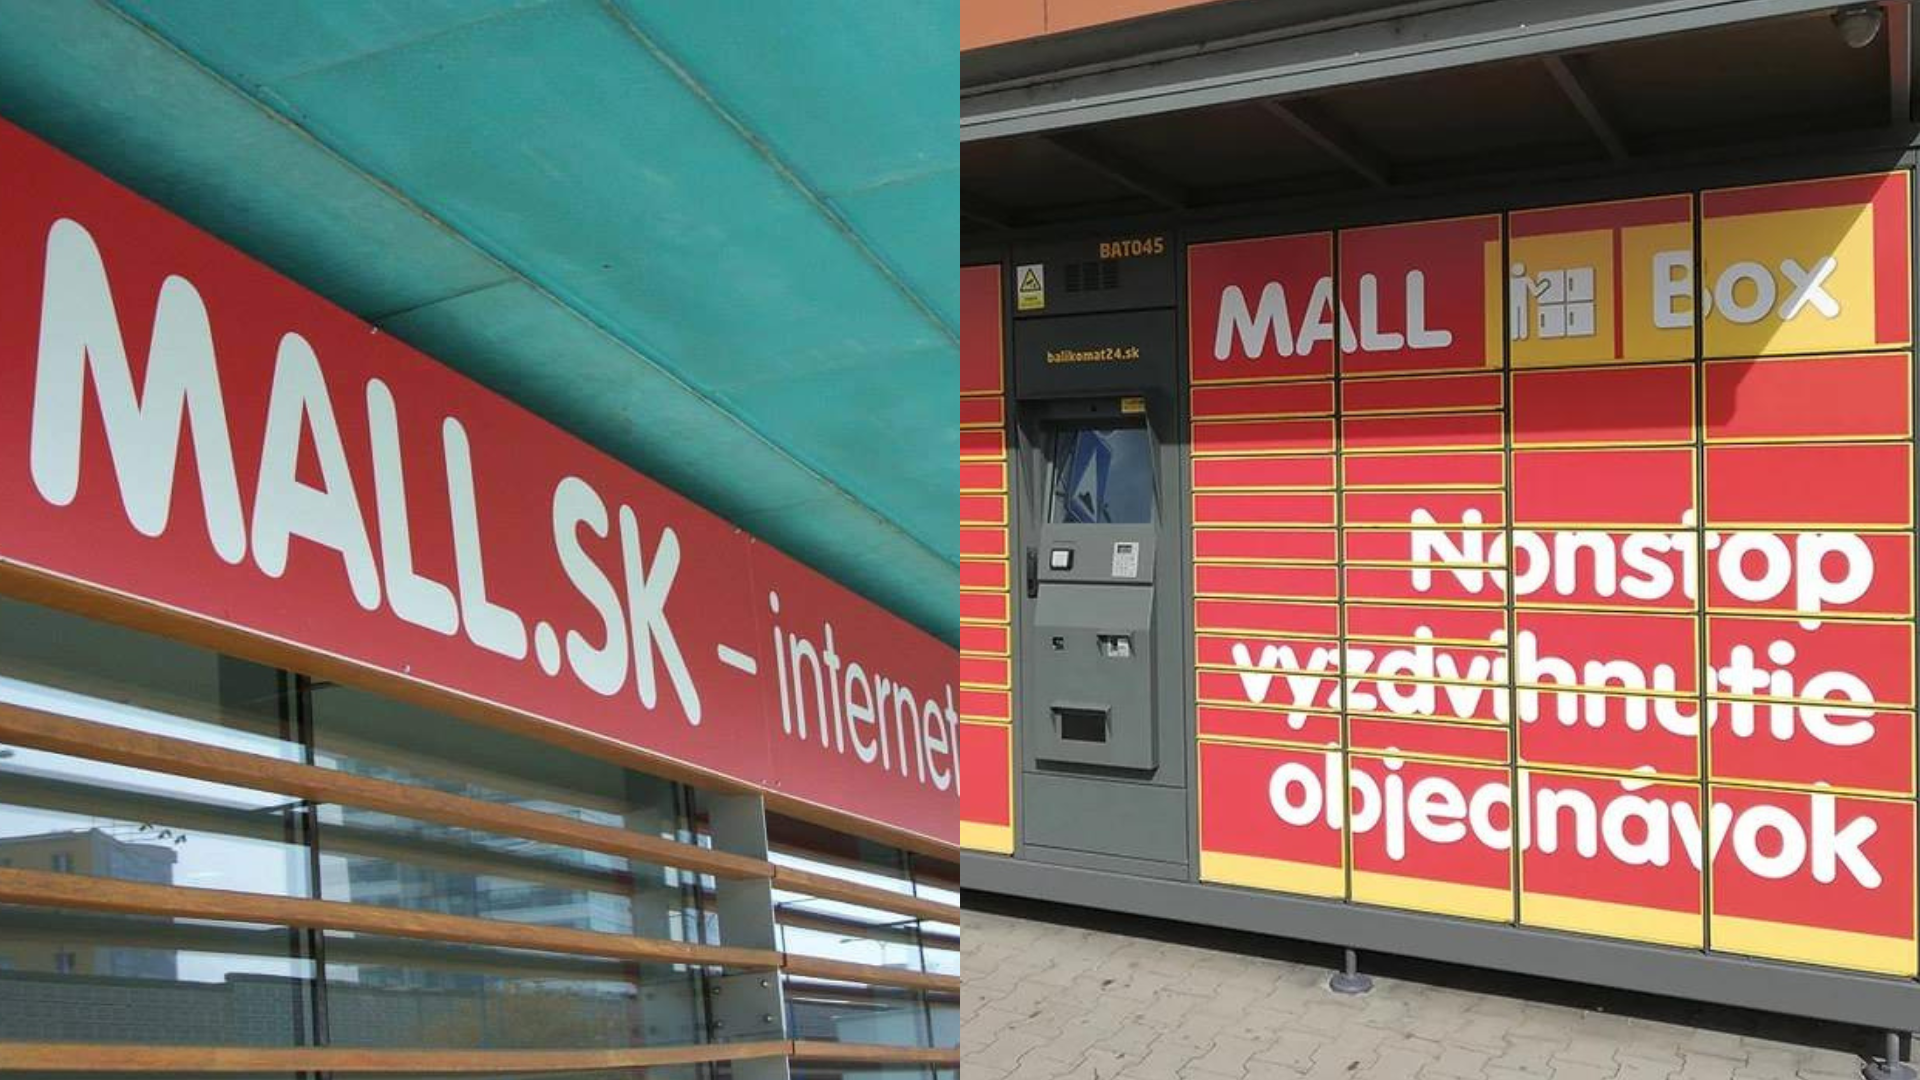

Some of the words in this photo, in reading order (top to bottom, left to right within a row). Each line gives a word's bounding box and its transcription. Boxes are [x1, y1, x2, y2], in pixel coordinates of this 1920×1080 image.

[1100, 237, 1164, 258] BAT045
[1047, 346, 1140, 363] balikomat24.sk
[1214, 269, 1453, 361] MALL
[30, 218, 702, 725] MALL.SK
[769, 590, 960, 797] internet
[1411, 508, 1874, 630] Nonstop
[1231, 625, 1875, 746] vyzdvihnutie
[1268, 741, 1882, 889] objednávok
